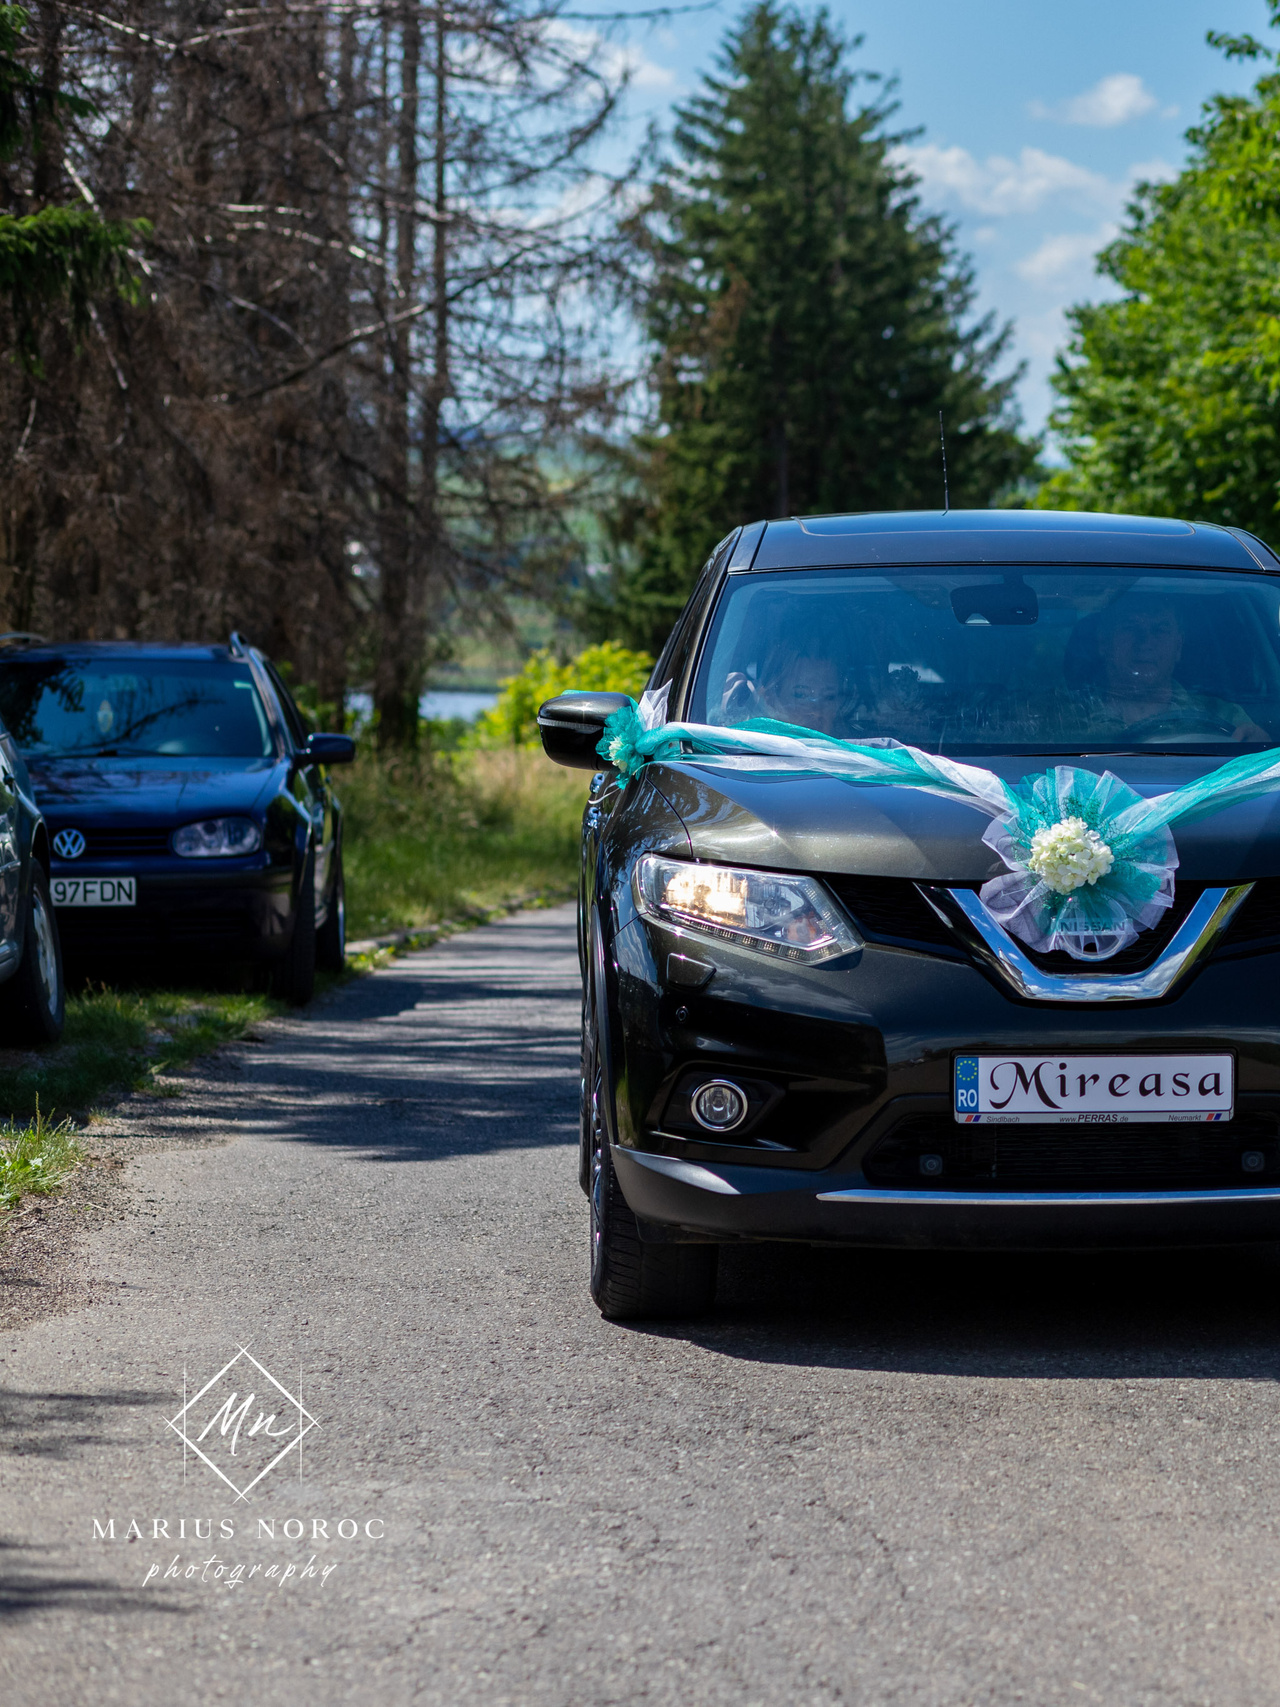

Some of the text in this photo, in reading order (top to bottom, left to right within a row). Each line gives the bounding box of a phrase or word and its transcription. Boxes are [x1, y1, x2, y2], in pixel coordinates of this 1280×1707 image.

[53, 880, 134, 903] 97FDN
[1059, 920, 1126, 932] NISSAN
[988, 1061, 1225, 1109] Mireasa
[958, 1089, 978, 1107] RO
[986, 1115, 1020, 1123] Sindlbach
[1059, 1114, 1129, 1123] www.PERRAS.de
